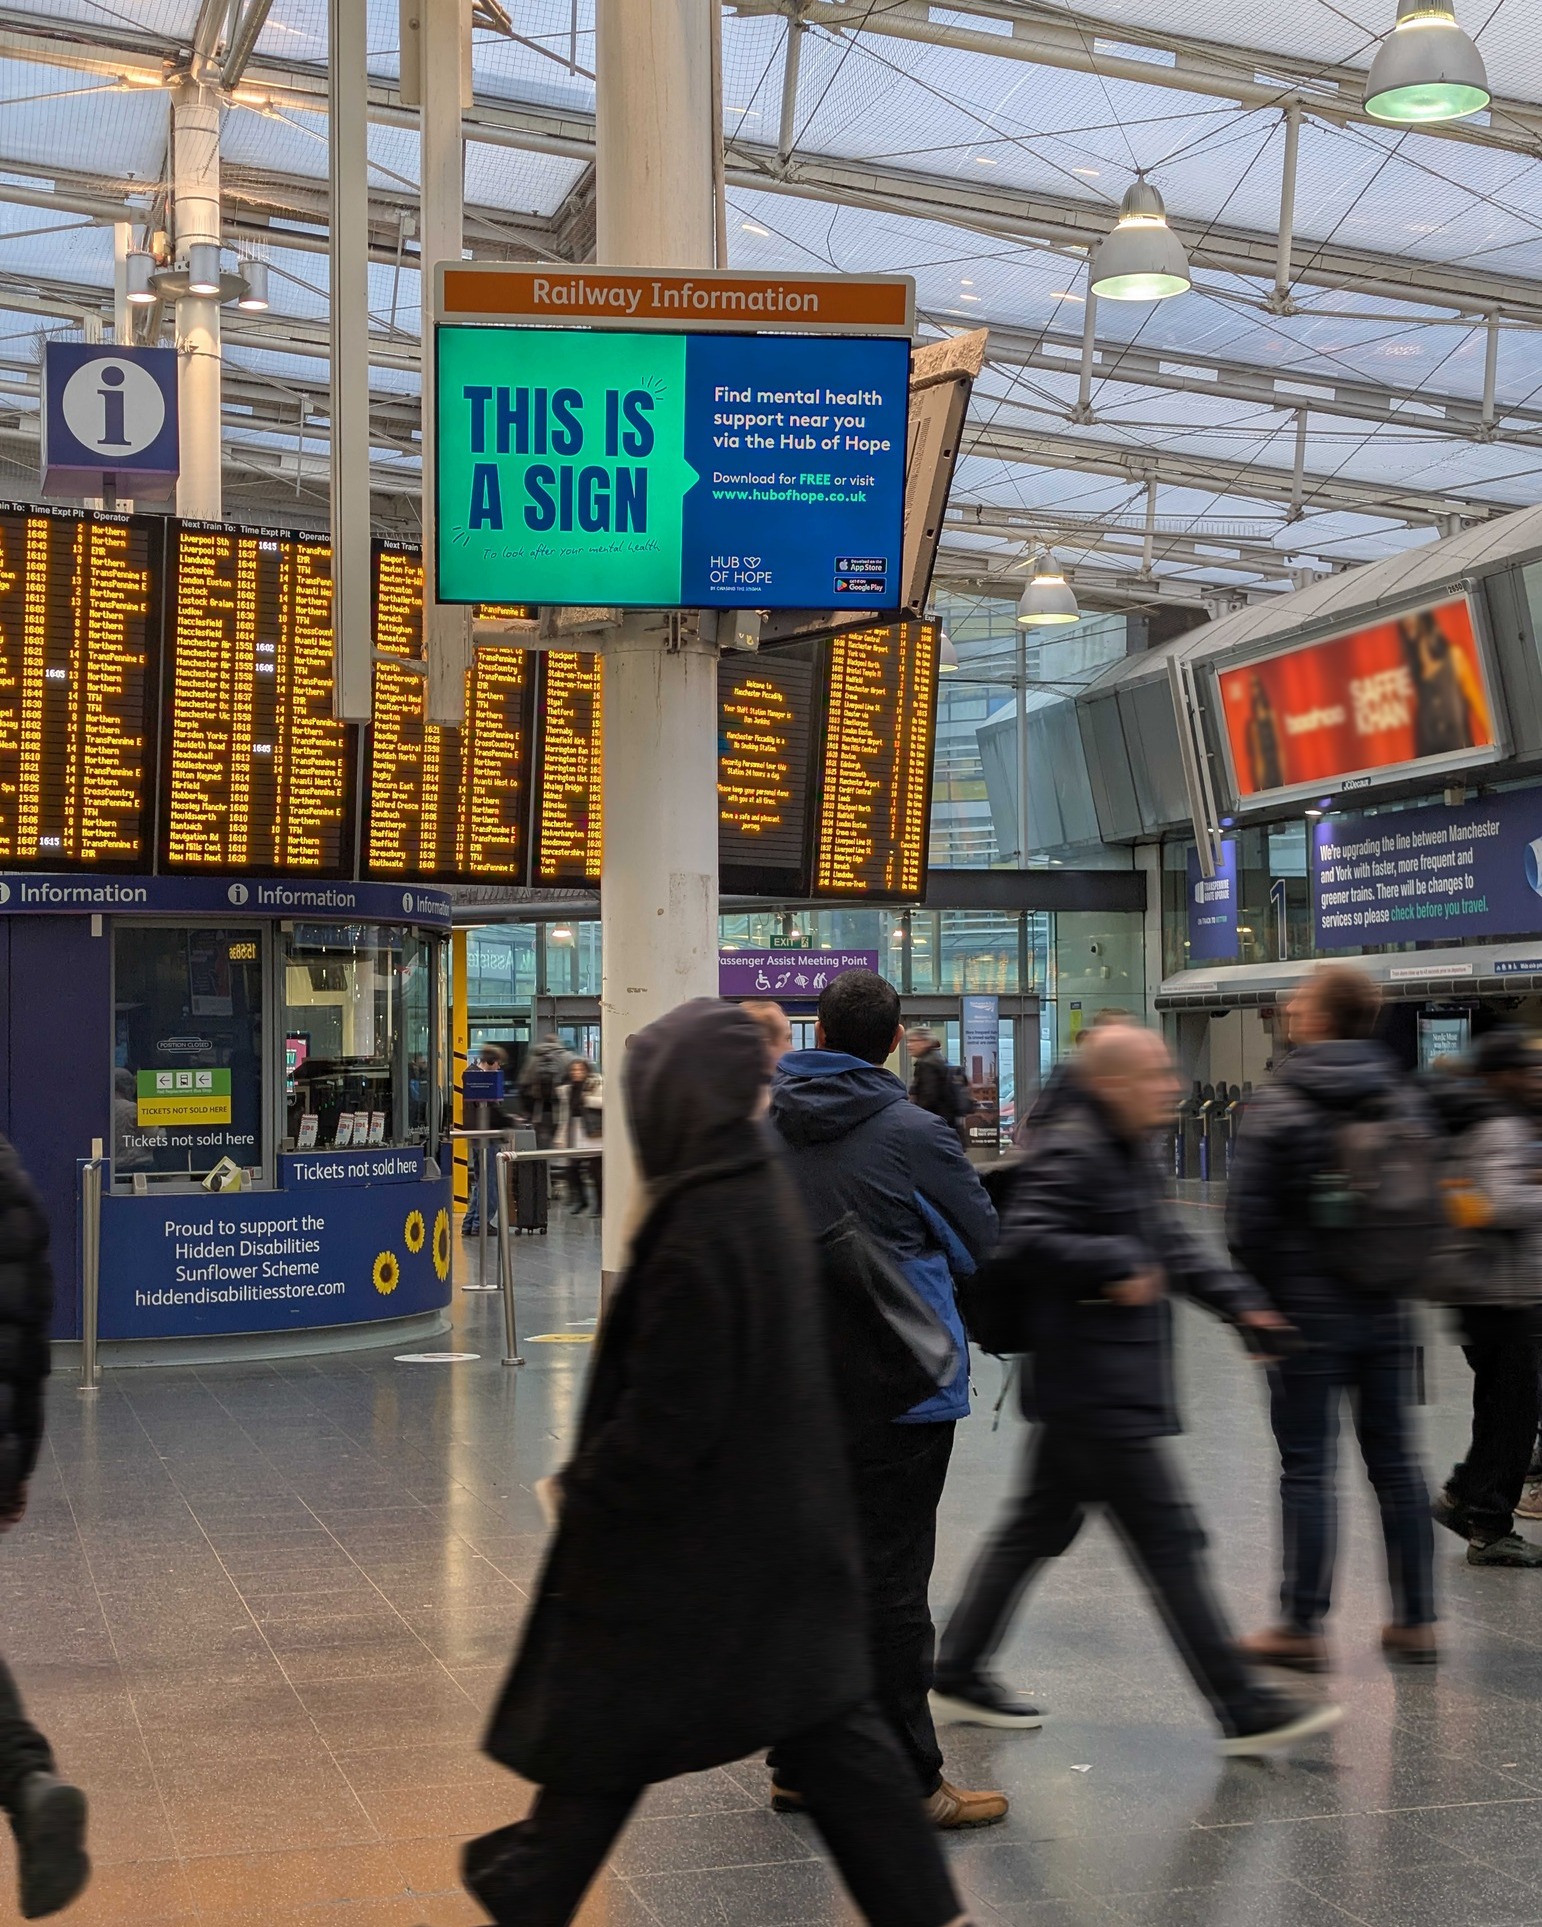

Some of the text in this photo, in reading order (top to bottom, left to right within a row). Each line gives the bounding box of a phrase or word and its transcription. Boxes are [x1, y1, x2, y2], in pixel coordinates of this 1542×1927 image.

[534, 279, 818, 313] Railway Information
[715, 387, 882, 405] Find mental health
[463, 385, 654, 457] THIS IS
[714, 413, 865, 431] support near you
[713, 433, 890, 455] via the Hub of Hope
[714, 472, 875, 486] Download for FREE or visit
[468, 463, 648, 534] A SIGN
[713, 489, 866, 504] www.hubofhope.co.uk
[12, 503, 25, 512] To:
[30, 505, 50, 514] Time
[52, 507, 71, 517] Expt
[73, 509, 84, 518] Plt
[94, 512, 129, 522] Operator
[27, 519, 126, 536] 16:03 2 Northern
[182, 520, 200, 529] Next
[202, 522, 221, 531] Train
[224, 524, 236, 532] To:
[241, 525, 259, 535] Time
[261, 528, 278, 537] Expt
[280, 530, 291, 538] Plt
[180, 533, 290, 551] Liverpool Sth 16:07 16:15 14
[384, 541, 418, 551] Next Train
[483, 539, 660, 560] To look after your mental health
[710, 556, 739, 568] HUB
[710, 571, 772, 583] OF HOPE
[23, 667, 122, 683] 16:04 16:05 13 Northern
[376, 673, 418, 684] Peterborough
[197, 772, 222, 781] Keynes
[231, 773, 249, 782] 16:14
[290, 777, 313, 785] Avanti
[315, 778, 332, 786] West
[334, 778, 342, 786] Co
[1344, 779, 1369, 790] JCDecaux
[19, 784, 135, 798] 16:25 4 CrossCountry
[1320, 821, 1500, 861] We're upgrading the line between Manchester
[1321, 847, 1473, 883] and York with faster, more frequent and
[21, 883, 147, 903] Information
[258, 885, 356, 908] Information
[1321, 873, 1474, 909] greener trains. There will be changes to
[1270, 879, 1287, 960] 1
[1322, 896, 1488, 928] services so please check before you travel.
[774, 938, 794, 946] EXIT
[767, 956, 795, 966] Assist
[798, 956, 839, 967] Meeting
[842, 956, 867, 966] Point
[123, 1133, 254, 1147] Tickets not sold here
[293, 1158, 417, 1180] Tickets not sold here
[165, 1215, 324, 1237] Proud to support the
[176, 1238, 320, 1259] Hidden Disabilities
[176, 1261, 319, 1282] Sunflower Scheme
[135, 1281, 345, 1306] hiddendisabilitiesstore.com
